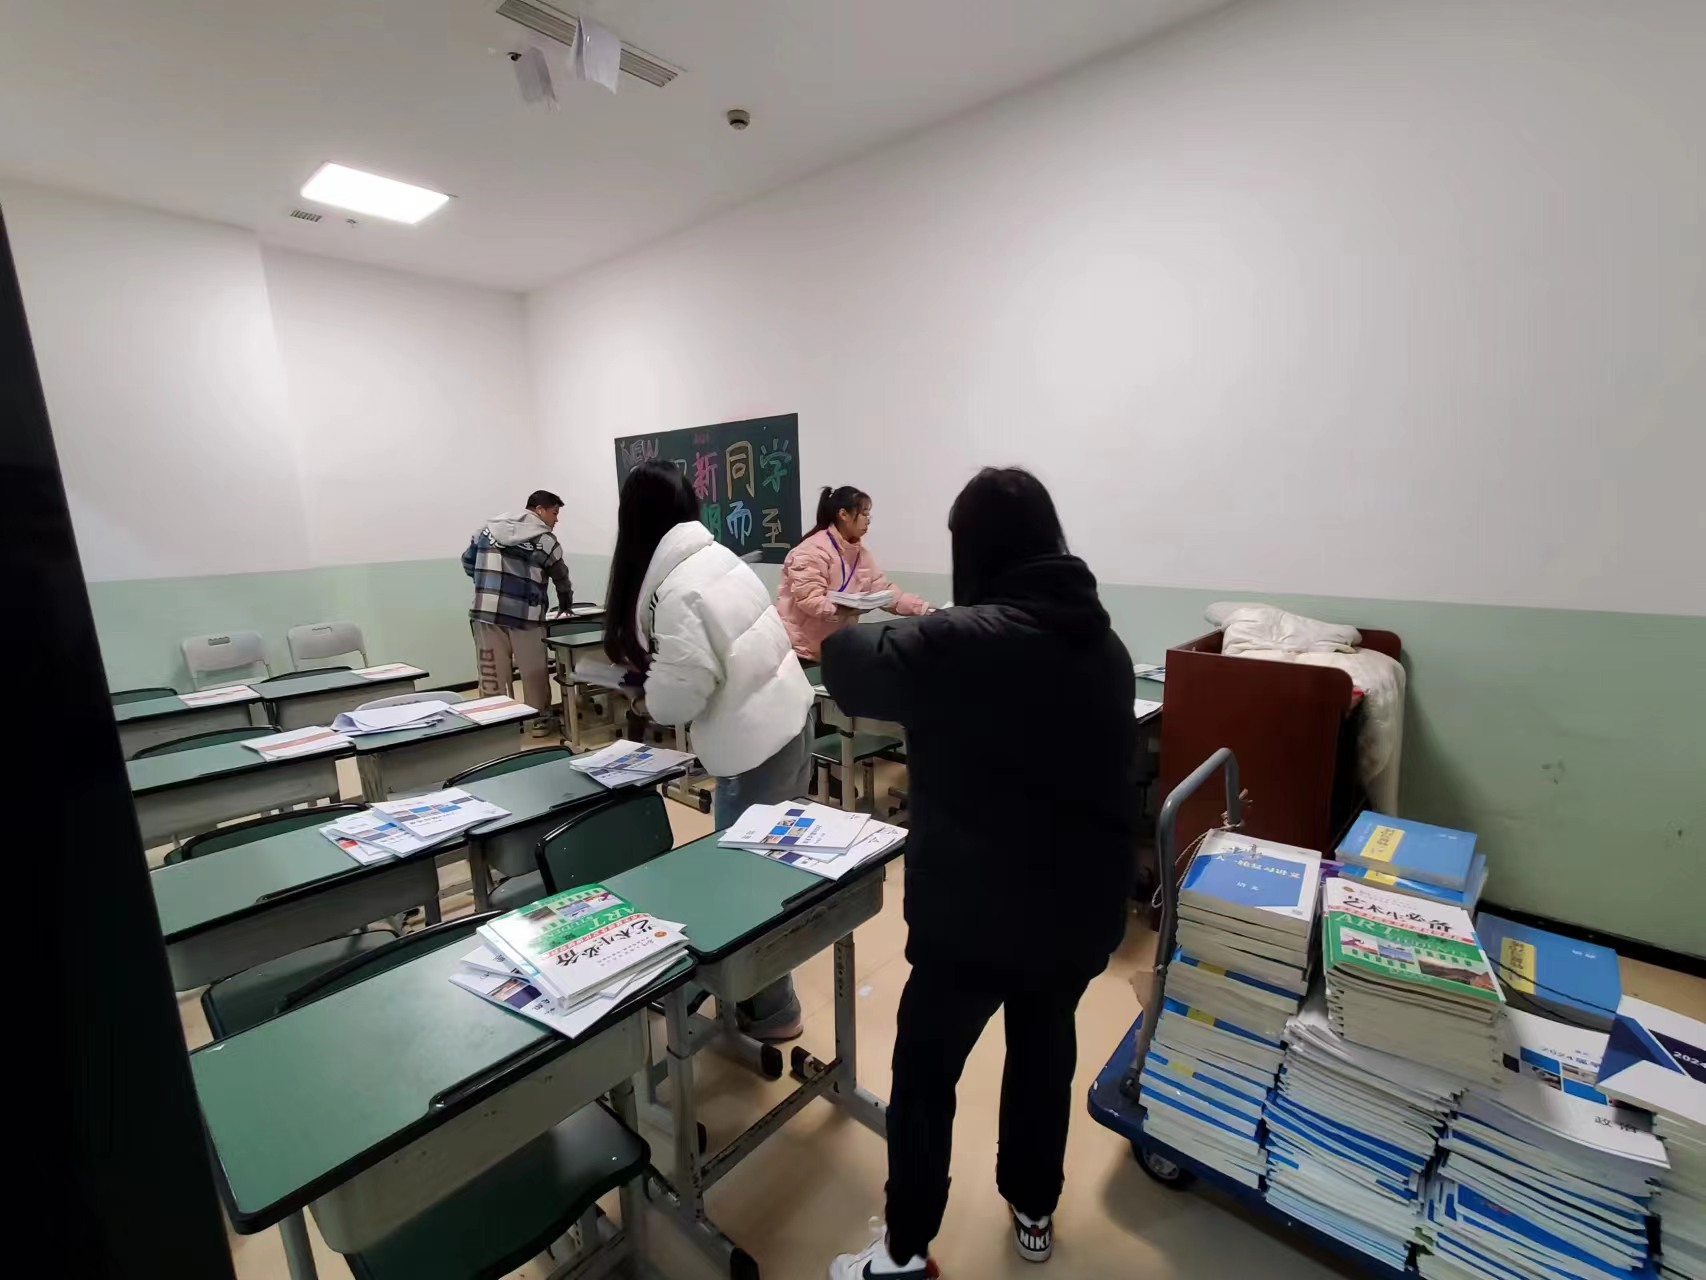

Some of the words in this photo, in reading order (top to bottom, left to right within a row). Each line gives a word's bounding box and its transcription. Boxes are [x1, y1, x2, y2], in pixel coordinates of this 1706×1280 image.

[589, 906, 635, 931] ART
[1335, 913, 1399, 937] ART
[1342, 895, 1453, 932] 艺术生必备
[556, 919, 657, 967] 艺术生必备
[1672, 1050, 1706, 1069] 2024
